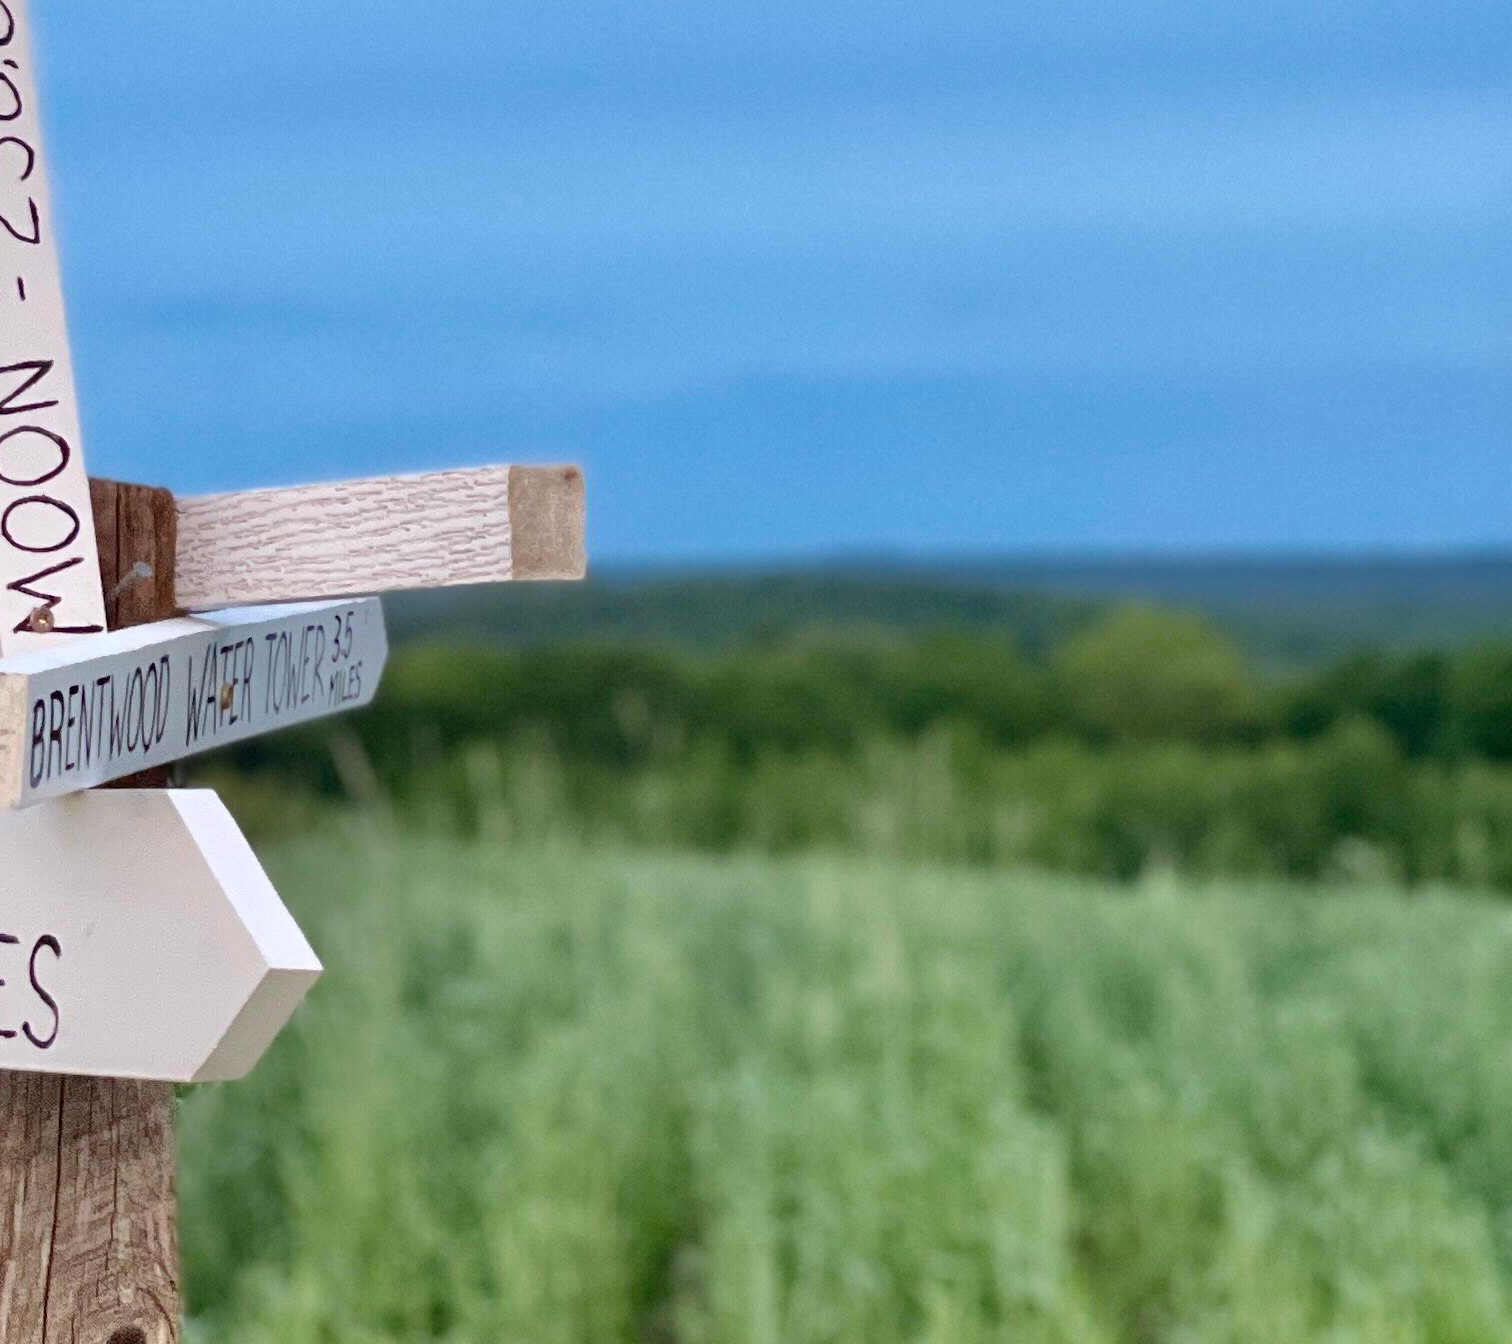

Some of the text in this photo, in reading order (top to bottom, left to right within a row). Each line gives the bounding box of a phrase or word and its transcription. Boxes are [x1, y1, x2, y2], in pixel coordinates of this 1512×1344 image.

[29, 655, 171, 788] BRENTWOOD
[185, 636, 255, 747] WATER
[263, 624, 326, 714] TOWER
[329, 659, 363, 707] MILES
